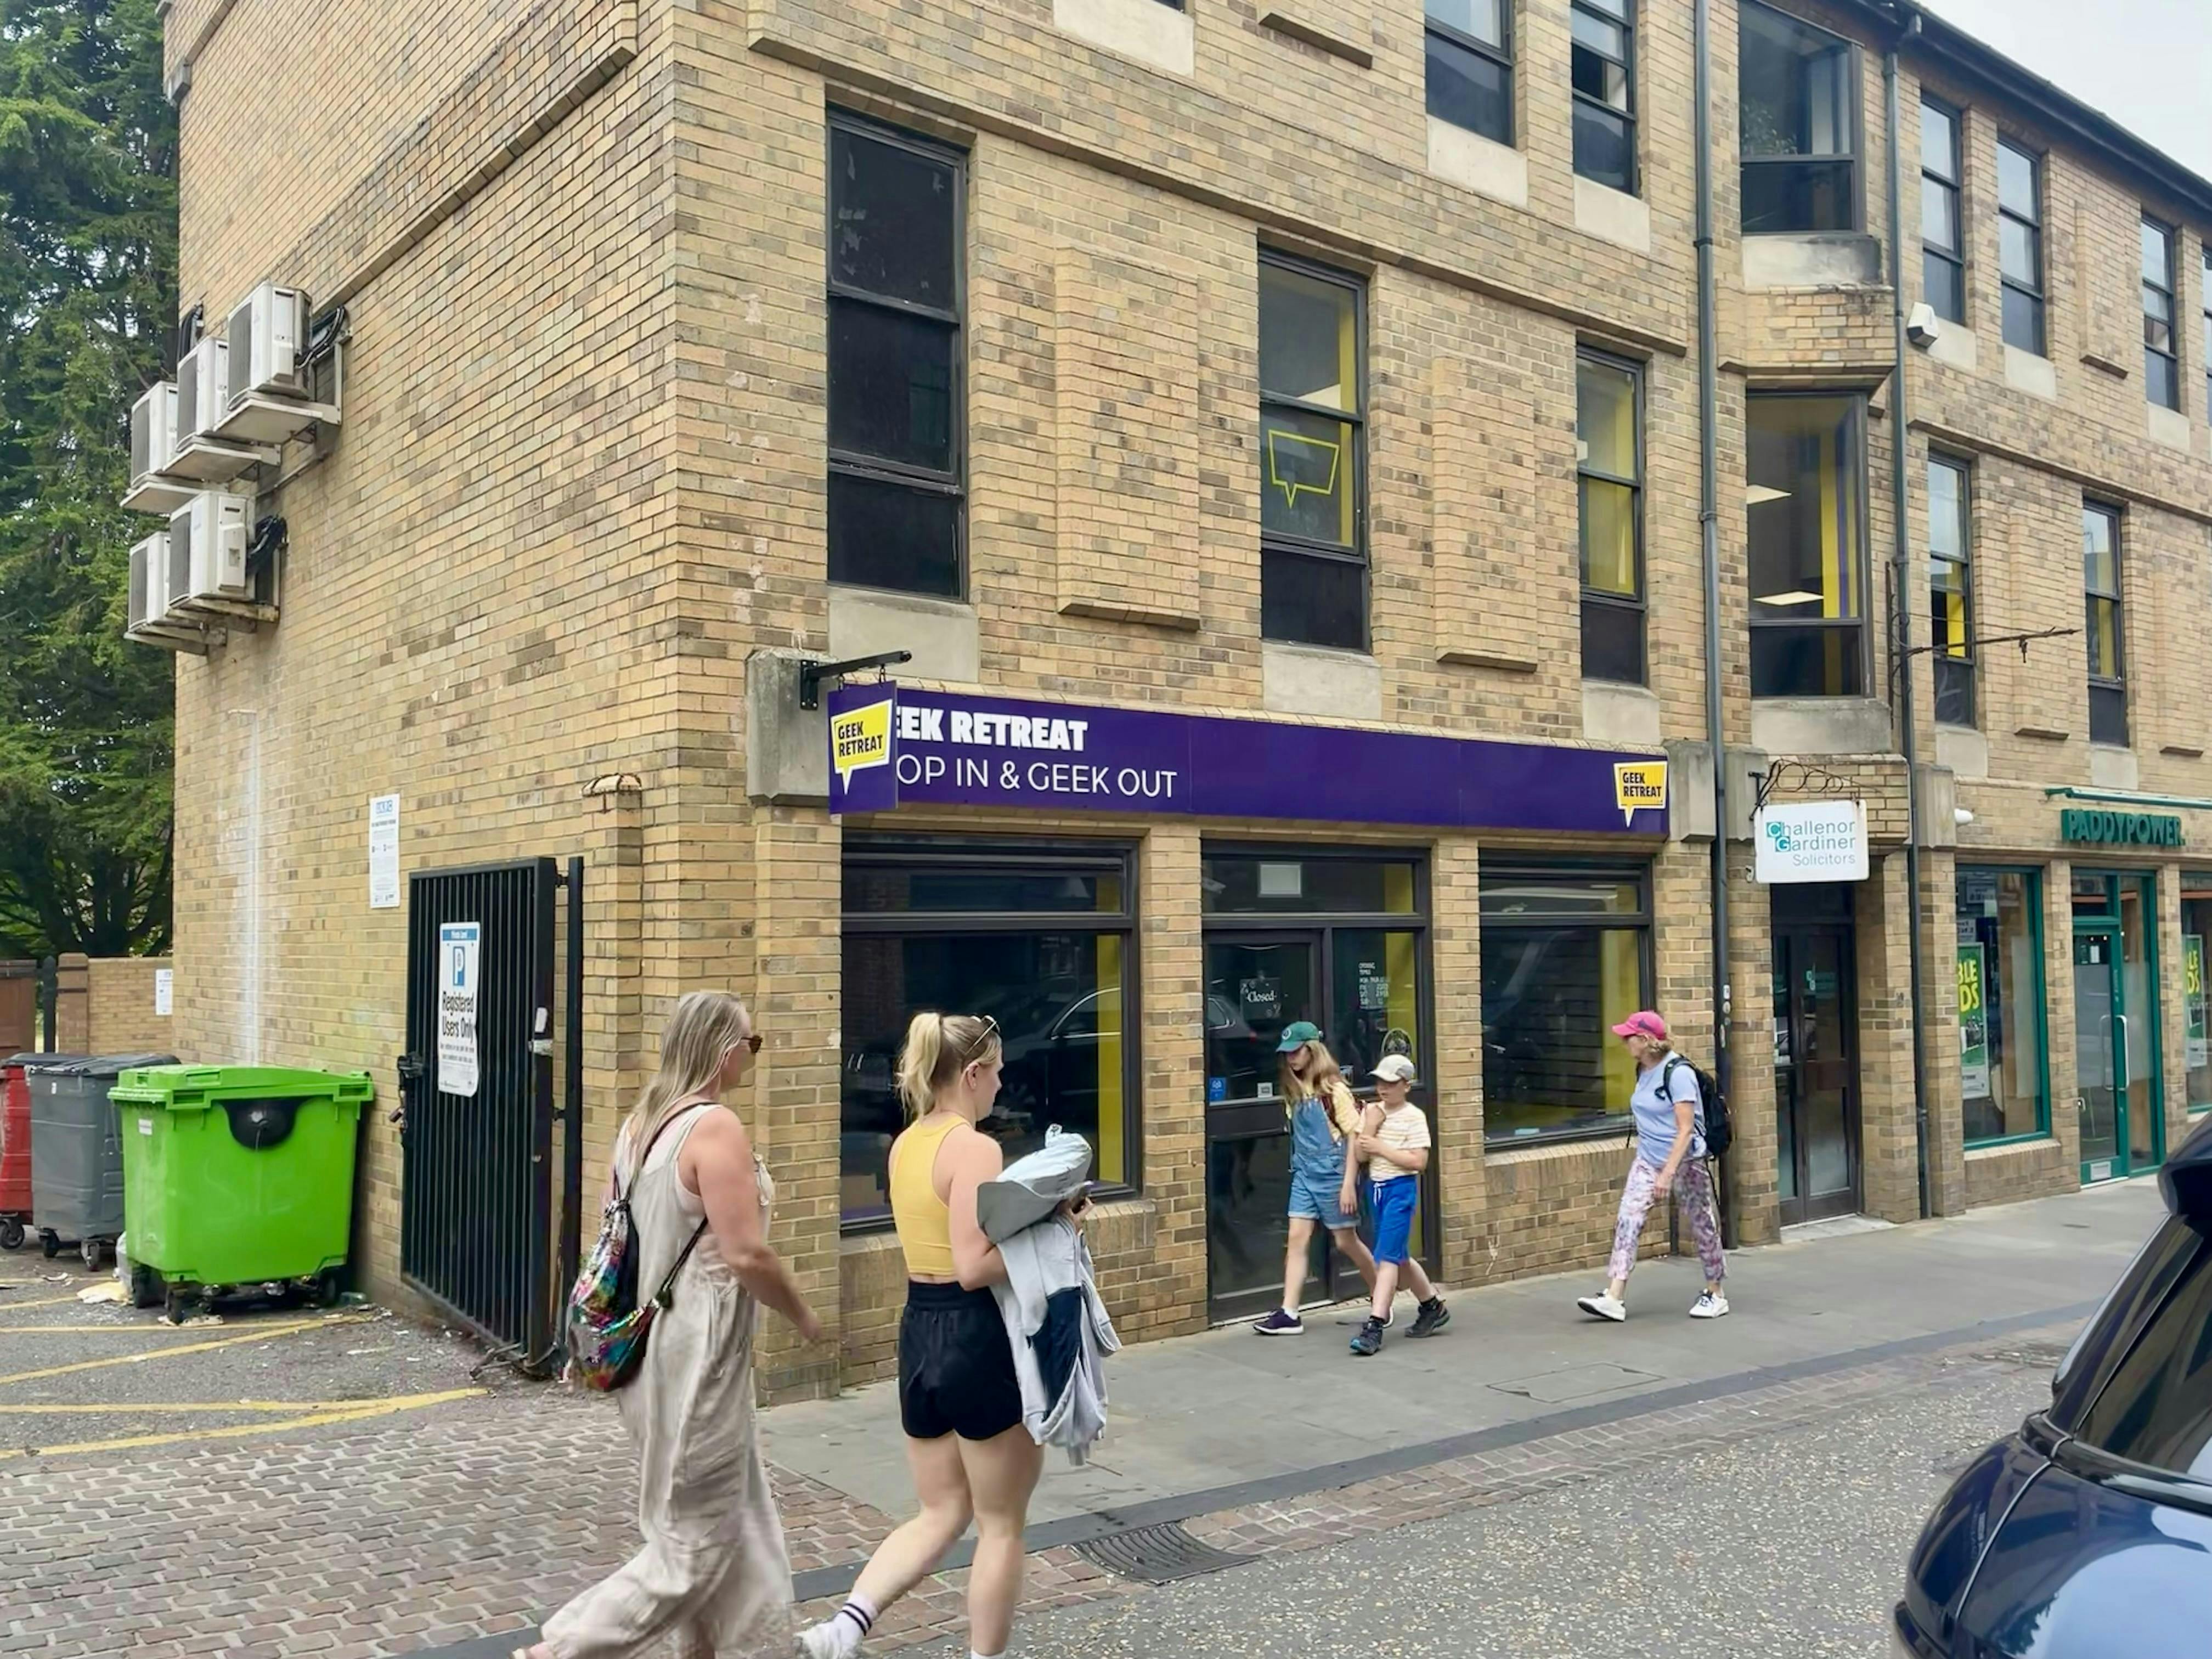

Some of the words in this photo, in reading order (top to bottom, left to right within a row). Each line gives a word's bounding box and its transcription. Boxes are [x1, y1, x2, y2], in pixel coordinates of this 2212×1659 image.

[838, 721, 864, 740] GEEK
[896, 706, 944, 742] EK
[951, 710, 1088, 752] RETREAT
[839, 735, 883, 757] RETREAT
[957, 758, 988, 787] IN
[1000, 760, 1020, 789] &
[1028, 761, 1110, 794] GEEK
[1118, 768, 1178, 798] OUT
[1623, 772, 1645, 784] GEEK
[1623, 786, 1662, 797] RETREAT
[1766, 821, 1856, 838] Challenor
[1775, 836, 1856, 852] Gardiner
[1792, 854, 1856, 866] Solicitors
[442, 990, 474, 1016] Registered
[1247, 990, 1274, 1003] Closed
[442, 1015, 460, 1038] Users
[461, 1017, 473, 1044] Only
